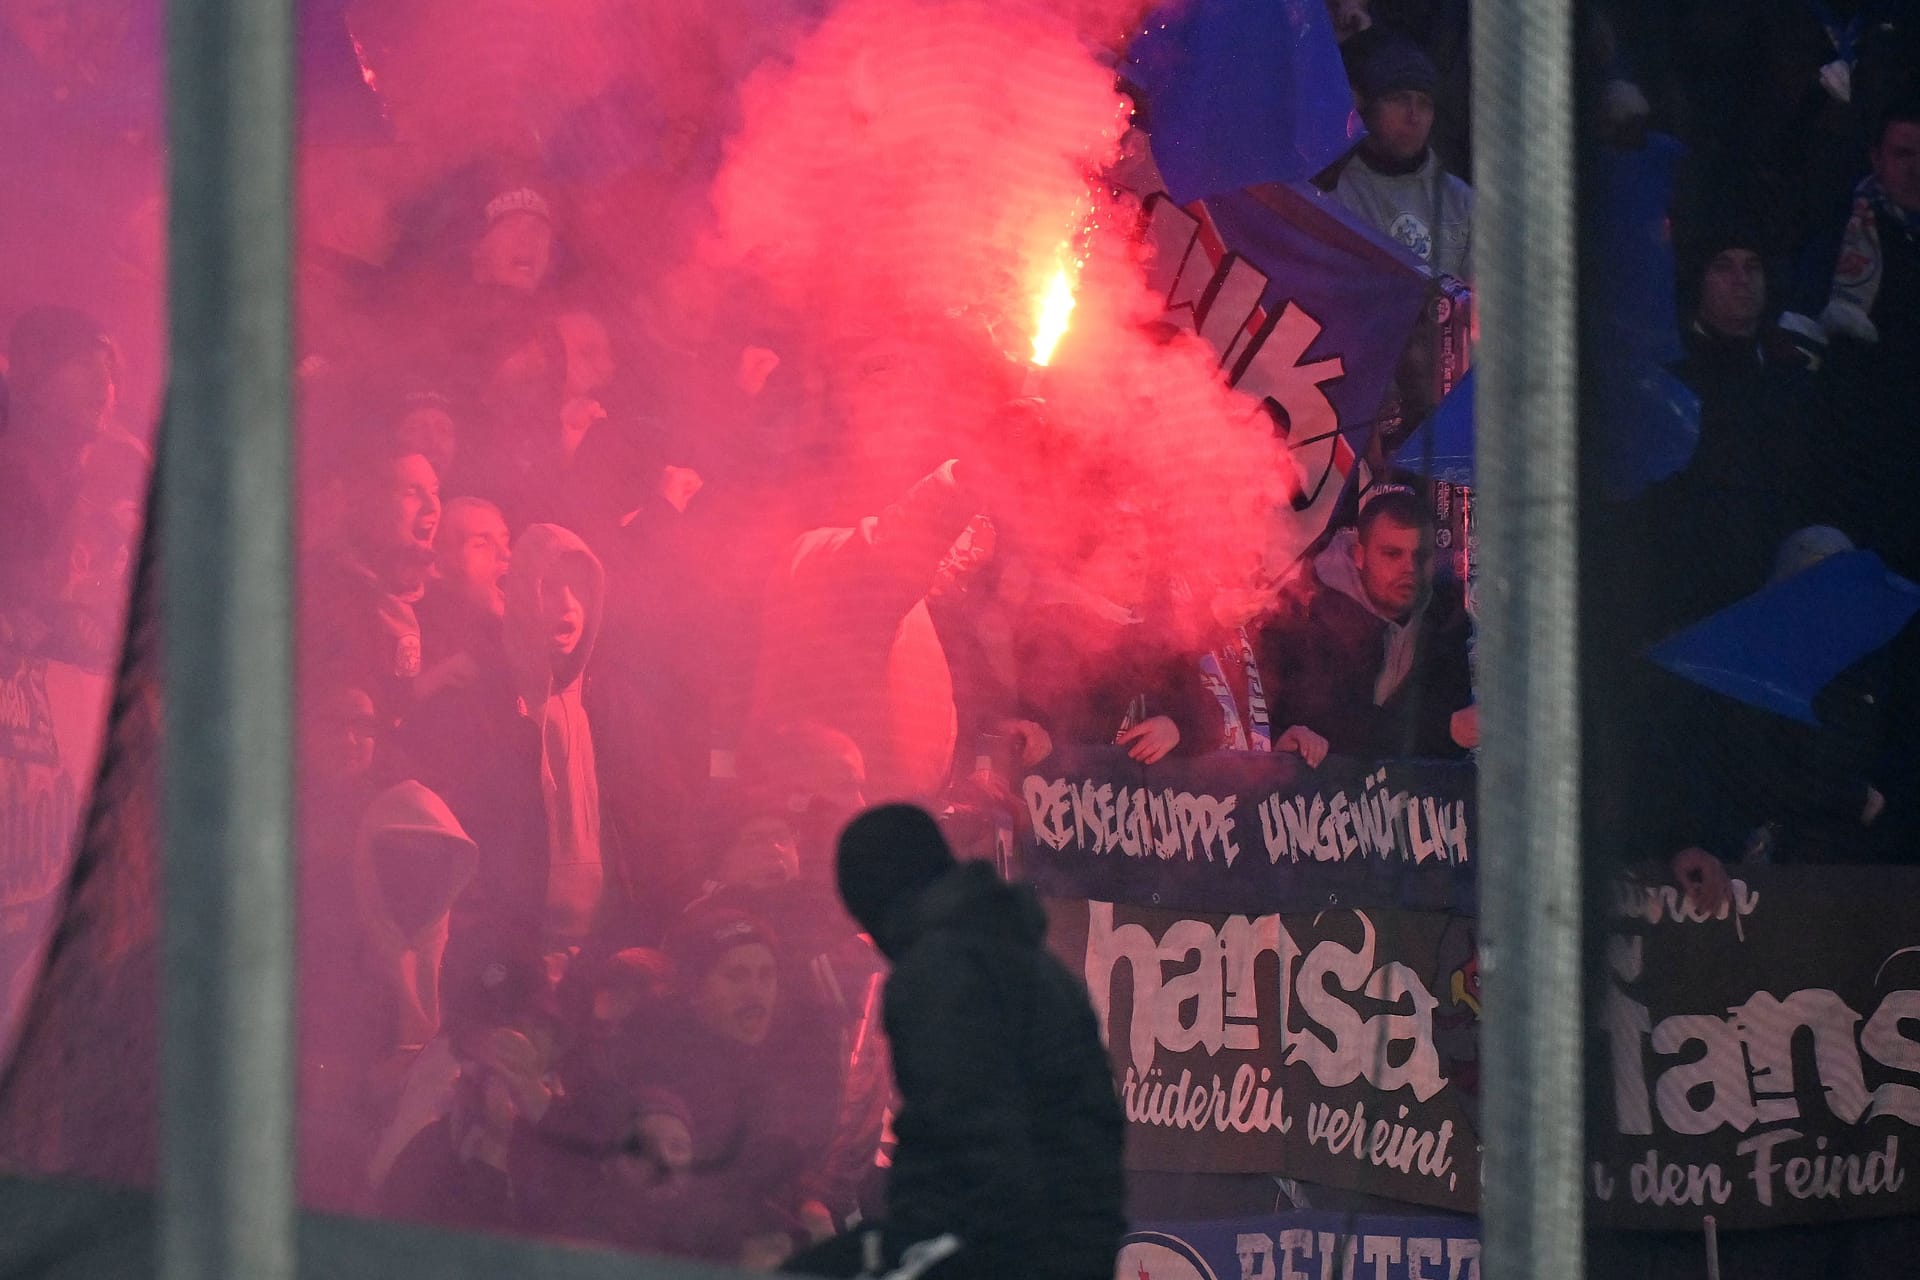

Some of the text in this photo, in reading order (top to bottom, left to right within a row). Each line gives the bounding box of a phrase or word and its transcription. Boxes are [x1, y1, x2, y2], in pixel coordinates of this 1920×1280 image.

[1258, 766, 1468, 867] UNGEMÜTLIH
[1307, 1101, 1457, 1193] vereint,
[1630, 1149, 1732, 1206] den
[1736, 1128, 1904, 1207] Feind
